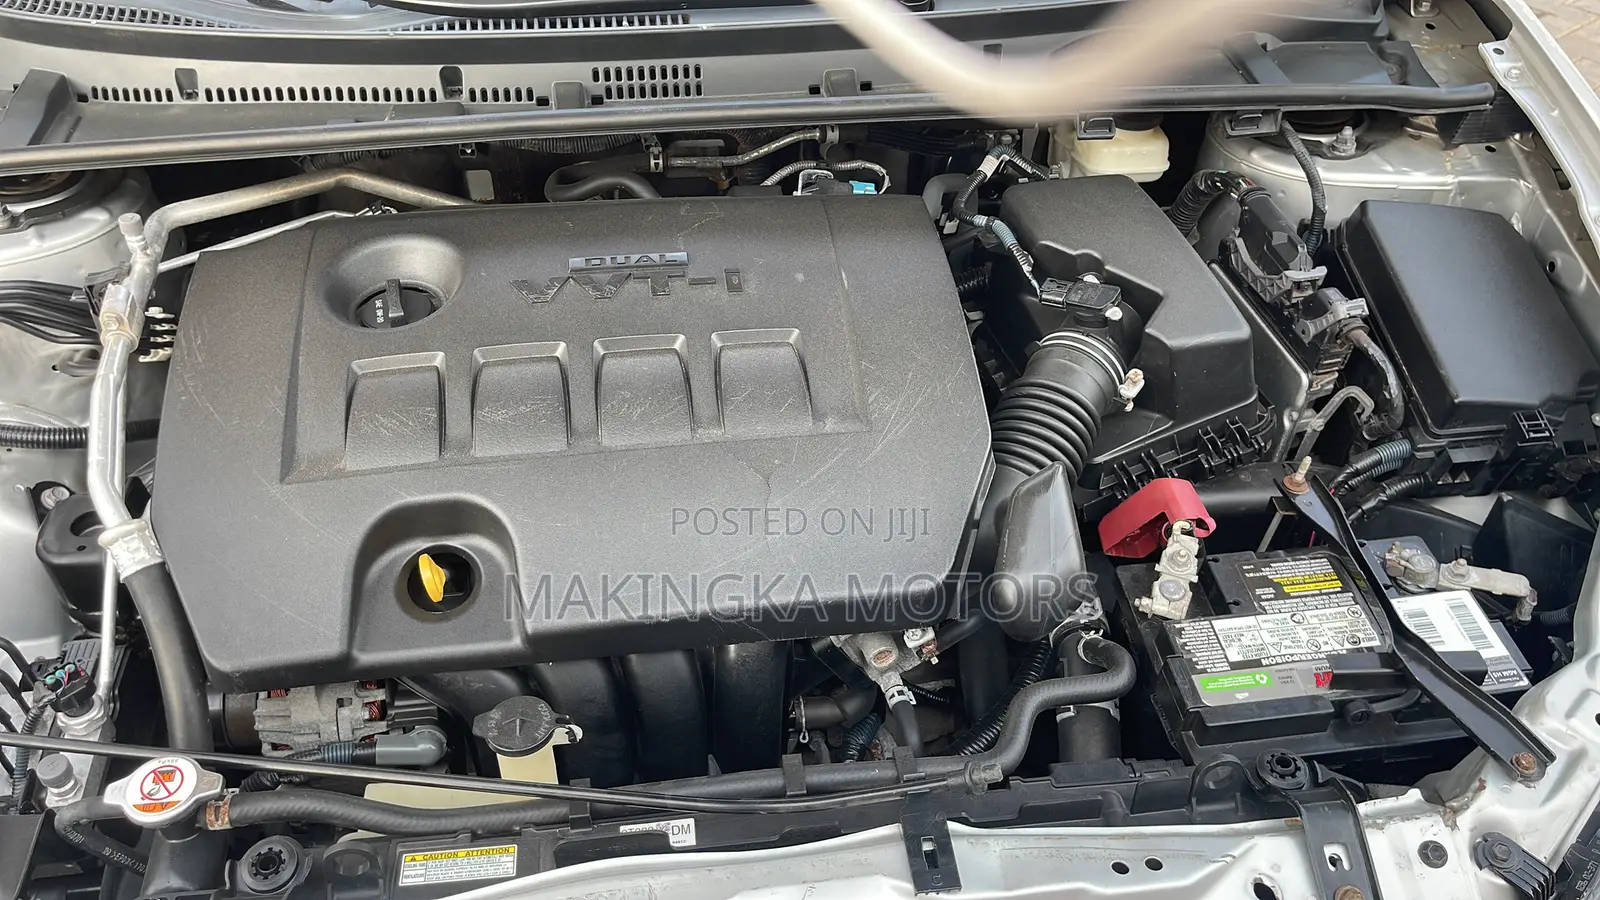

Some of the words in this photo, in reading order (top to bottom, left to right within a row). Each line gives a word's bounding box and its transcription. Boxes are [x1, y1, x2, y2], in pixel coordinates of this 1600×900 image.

[584, 253, 679, 267] DUAL
[375, 299, 383, 308] SAE
[671, 823, 691, 836] DM
[422, 851, 459, 861] CAUTION
[464, 846, 510, 858] ATTENTION
